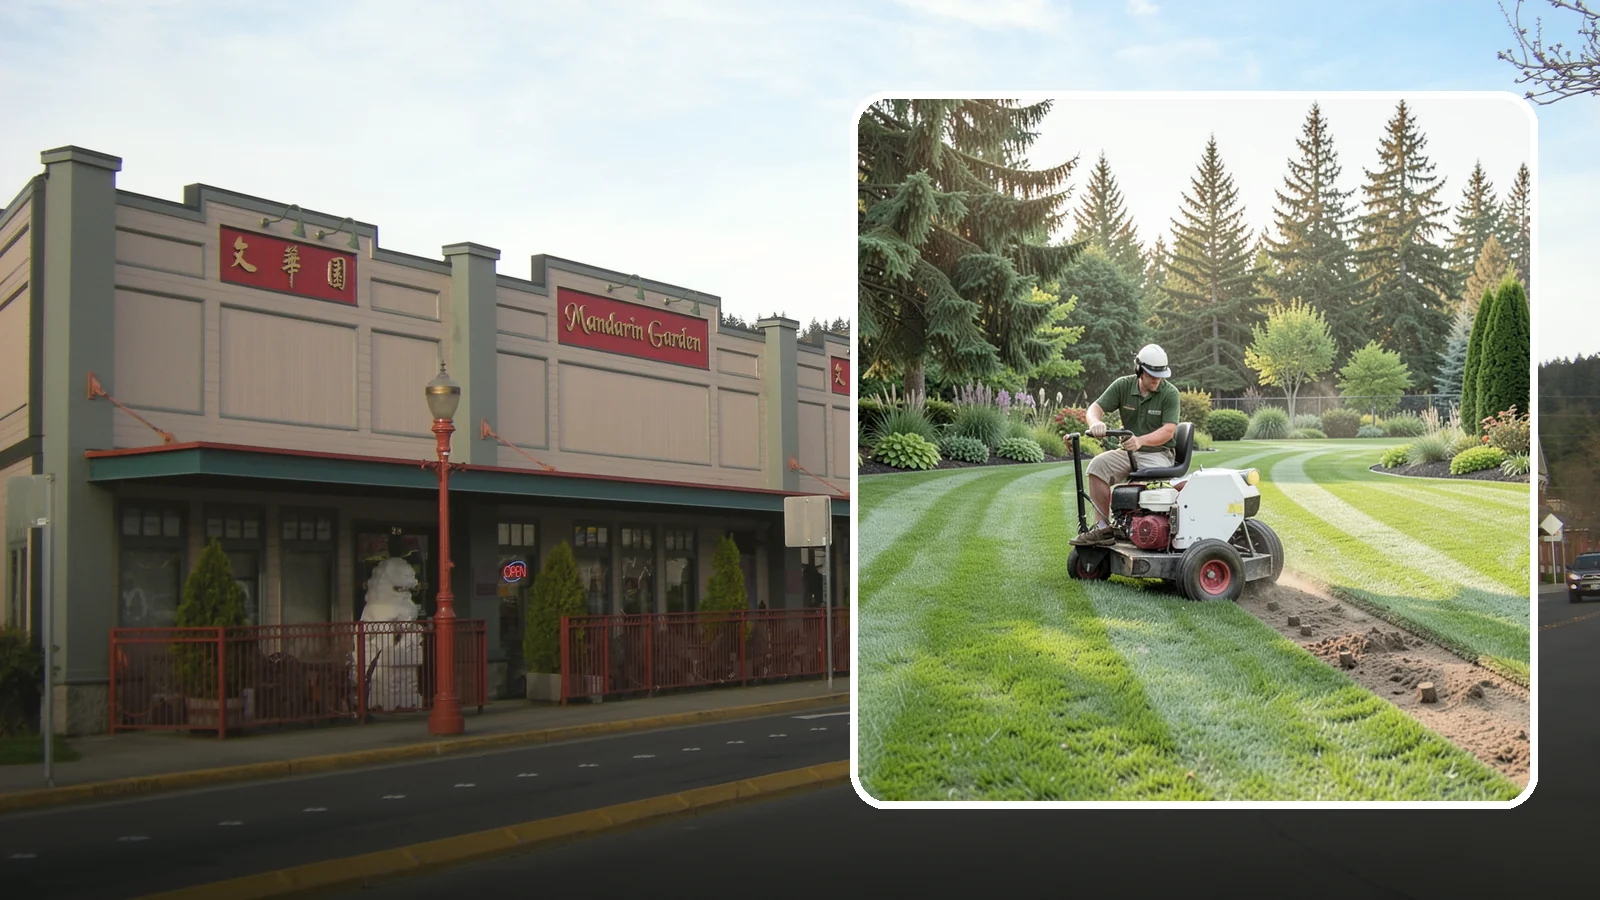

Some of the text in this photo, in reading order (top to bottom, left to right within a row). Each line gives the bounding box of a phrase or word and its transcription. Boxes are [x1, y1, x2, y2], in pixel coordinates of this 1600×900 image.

[564, 302, 701, 352] Mandarin Garden
[503, 565, 527, 578] OPEN
